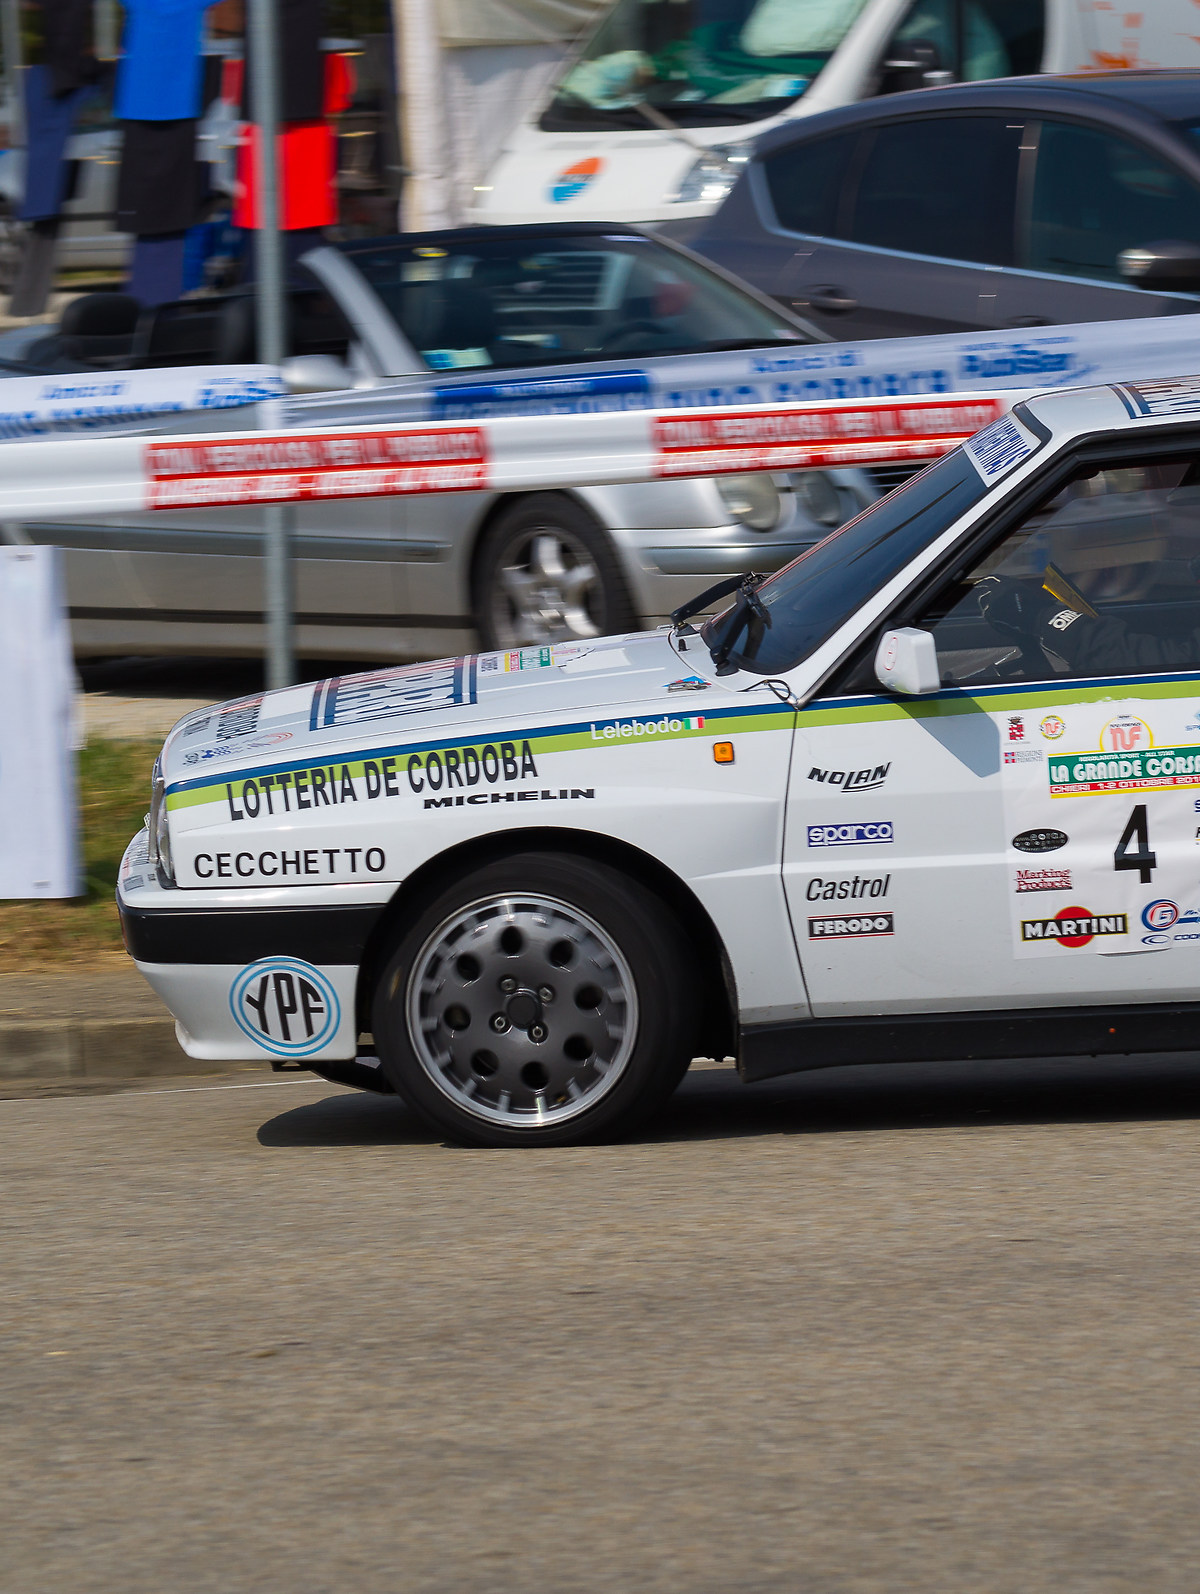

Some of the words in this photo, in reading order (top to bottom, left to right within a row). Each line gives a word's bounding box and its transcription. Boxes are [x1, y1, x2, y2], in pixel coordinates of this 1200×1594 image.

[590, 716, 682, 741] Lelebodo
[226, 764, 358, 822] LOTTERIA
[365, 756, 400, 800] DE
[408, 740, 539, 794] CORDOBA
[808, 761, 894, 790] NOLAN
[1051, 765, 1070, 783] LA
[1073, 759, 1142, 781] GRANDE
[1118, 777, 1174, 789] OTTOBRE
[423, 788, 596, 810] MICHELIN
[808, 822, 893, 845] sparco
[1113, 804, 1158, 884] 4
[194, 847, 387, 879] CECCHETTO
[806, 873, 892, 902] Castrol
[812, 917, 889, 935] FERODO
[1024, 917, 1123, 938] MARTINI
[246, 971, 326, 1042] YPF
